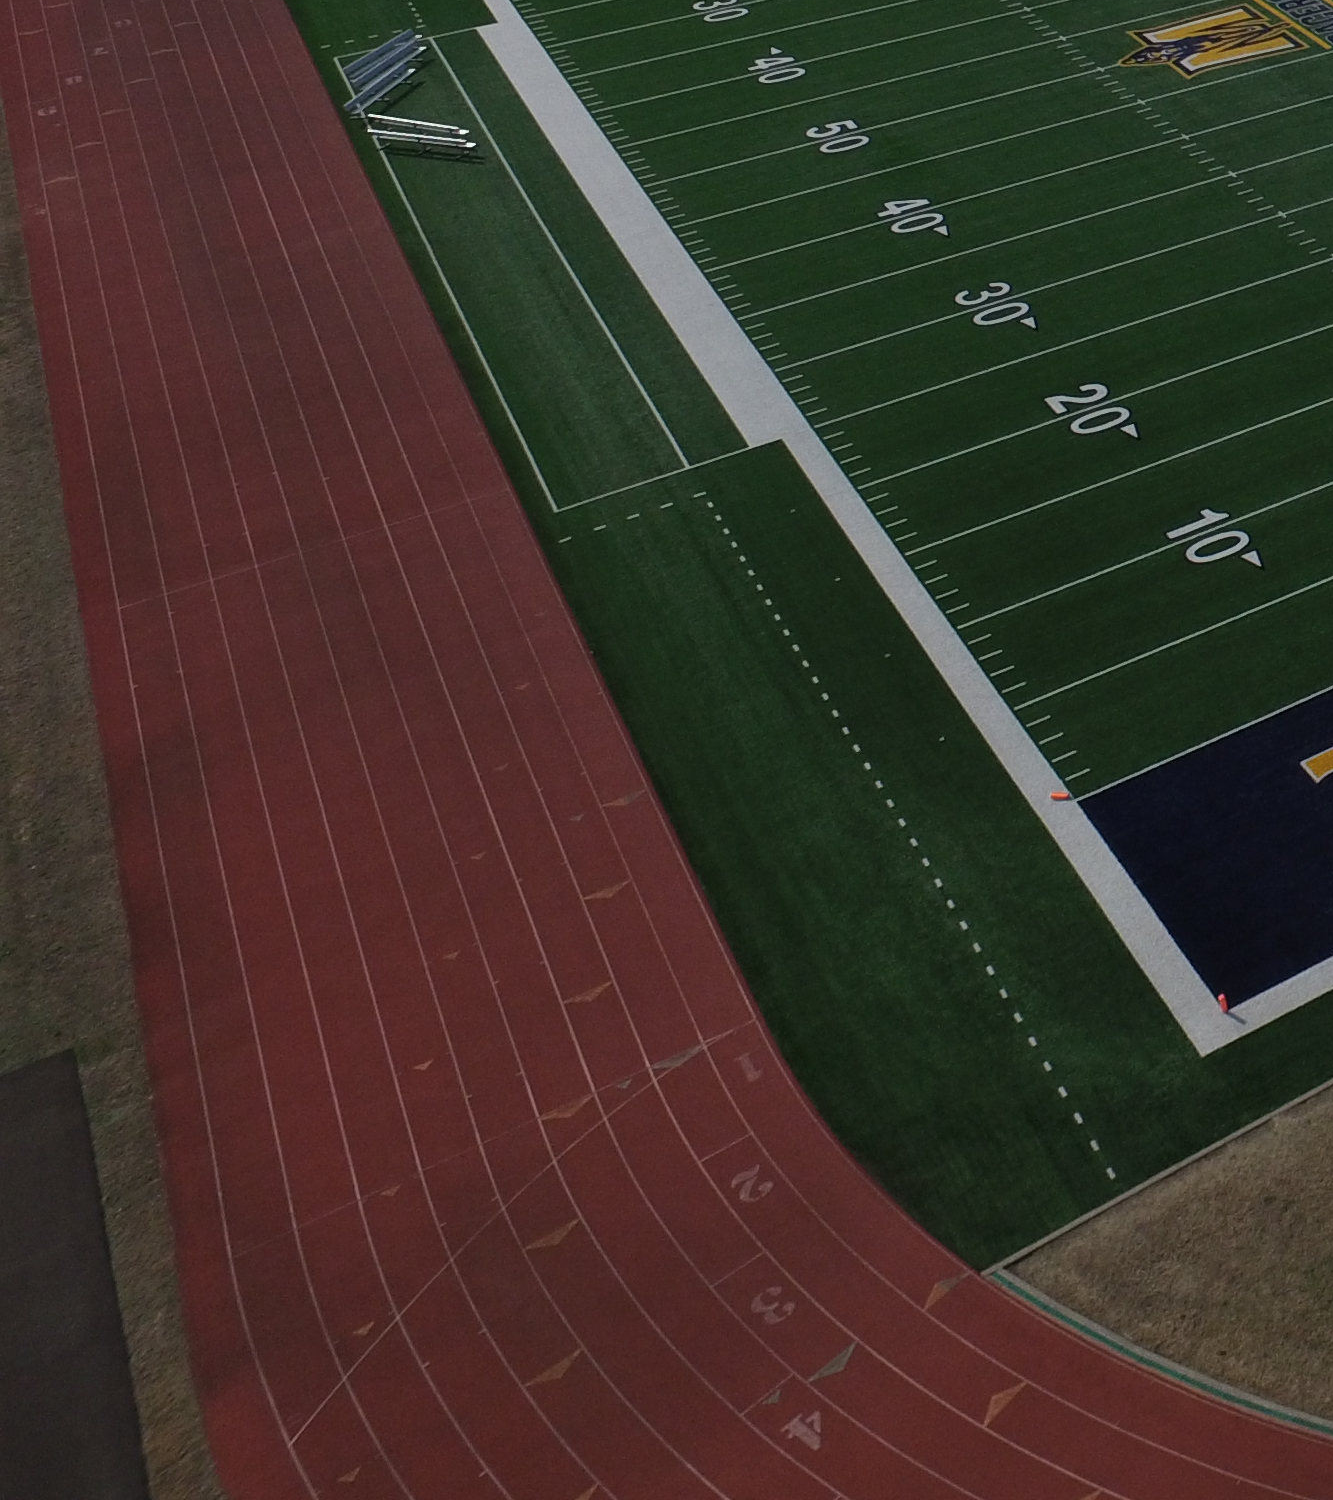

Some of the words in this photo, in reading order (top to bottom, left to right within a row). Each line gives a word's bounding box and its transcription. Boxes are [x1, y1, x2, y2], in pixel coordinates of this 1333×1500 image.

[748, 56, 806, 84] 40
[805, 119, 870, 154] 50
[877, 199, 944, 234] 40
[954, 281, 1030, 326] 30
[1044, 383, 1131, 435] 20
[1165, 508, 1251, 564] 10
[735, 1052, 762, 1082] 1
[731, 1164, 775, 1203] 2
[751, 1286, 796, 1325] 3
[781, 1411, 822, 1451] 4
